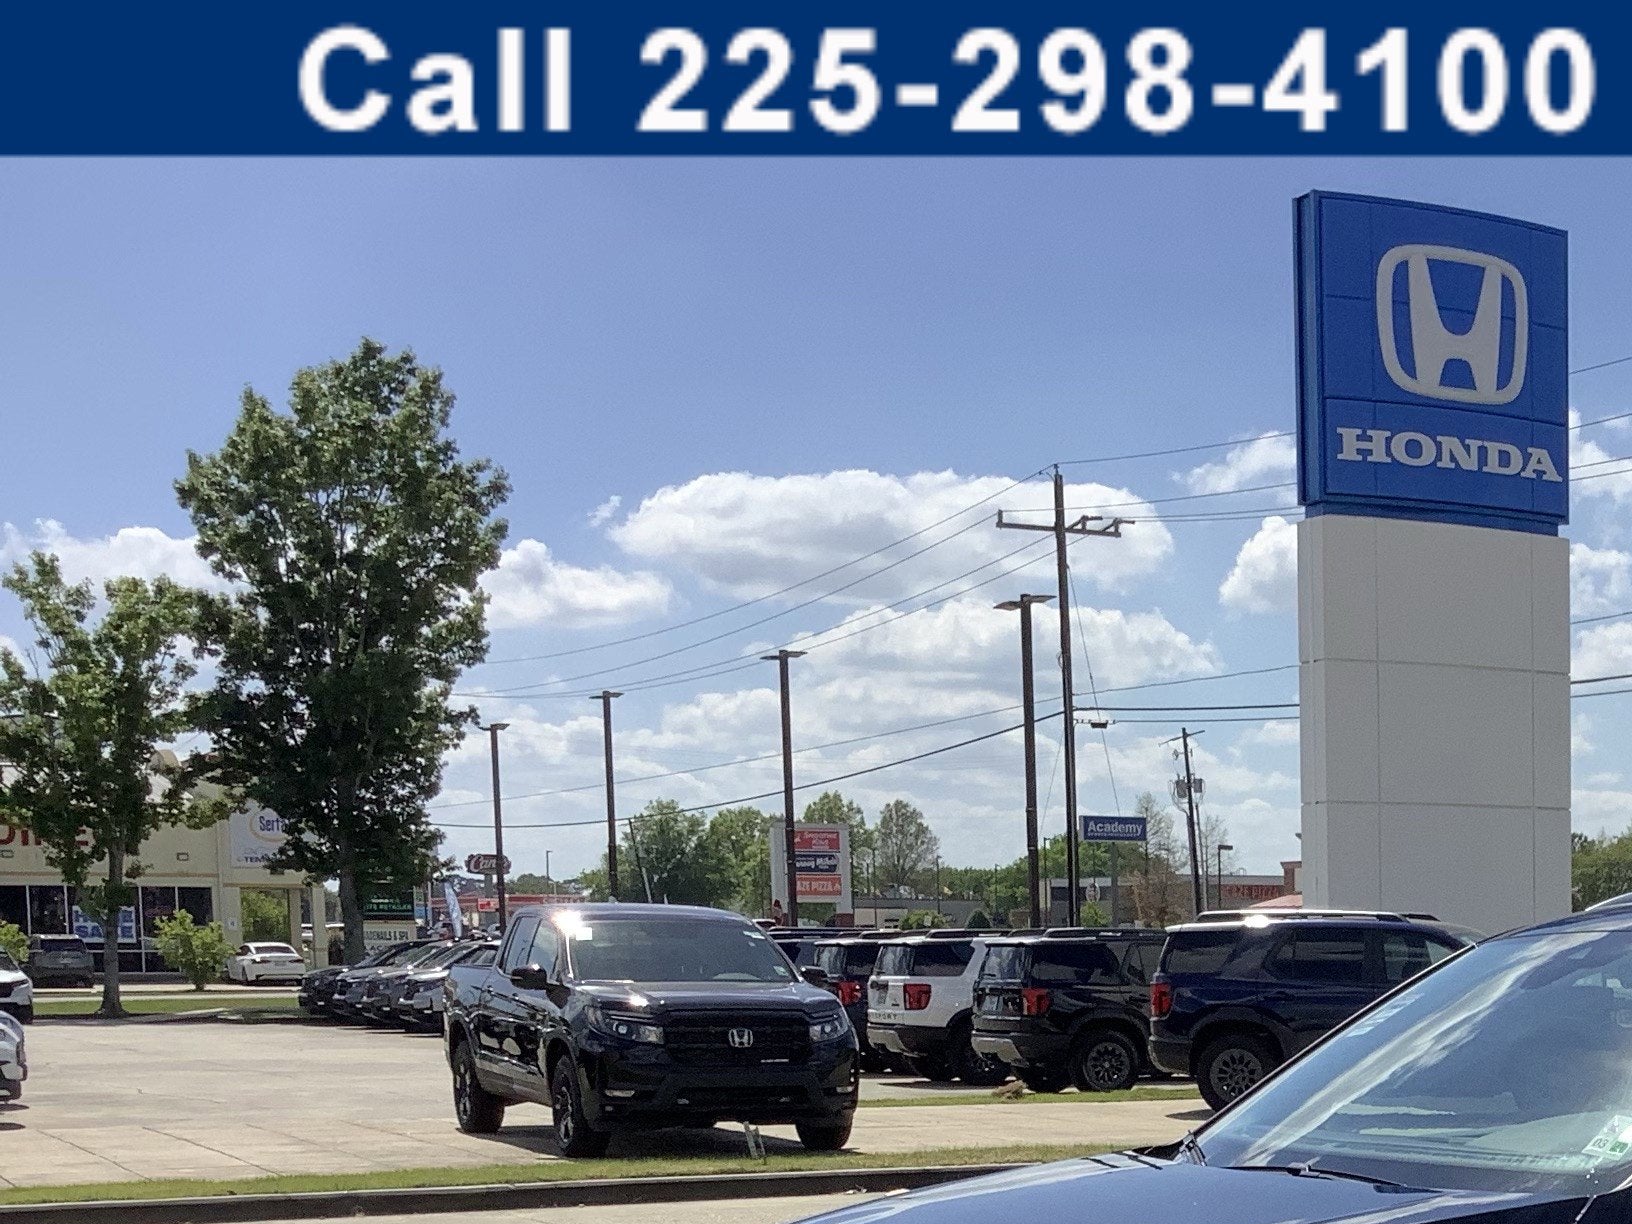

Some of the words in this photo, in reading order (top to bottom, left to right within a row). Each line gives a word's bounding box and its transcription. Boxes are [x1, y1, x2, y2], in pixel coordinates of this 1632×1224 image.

[1336, 427, 1562, 482] HONDA
[1088, 820, 1144, 836] Academy
[75, 925, 134, 939] SAE
